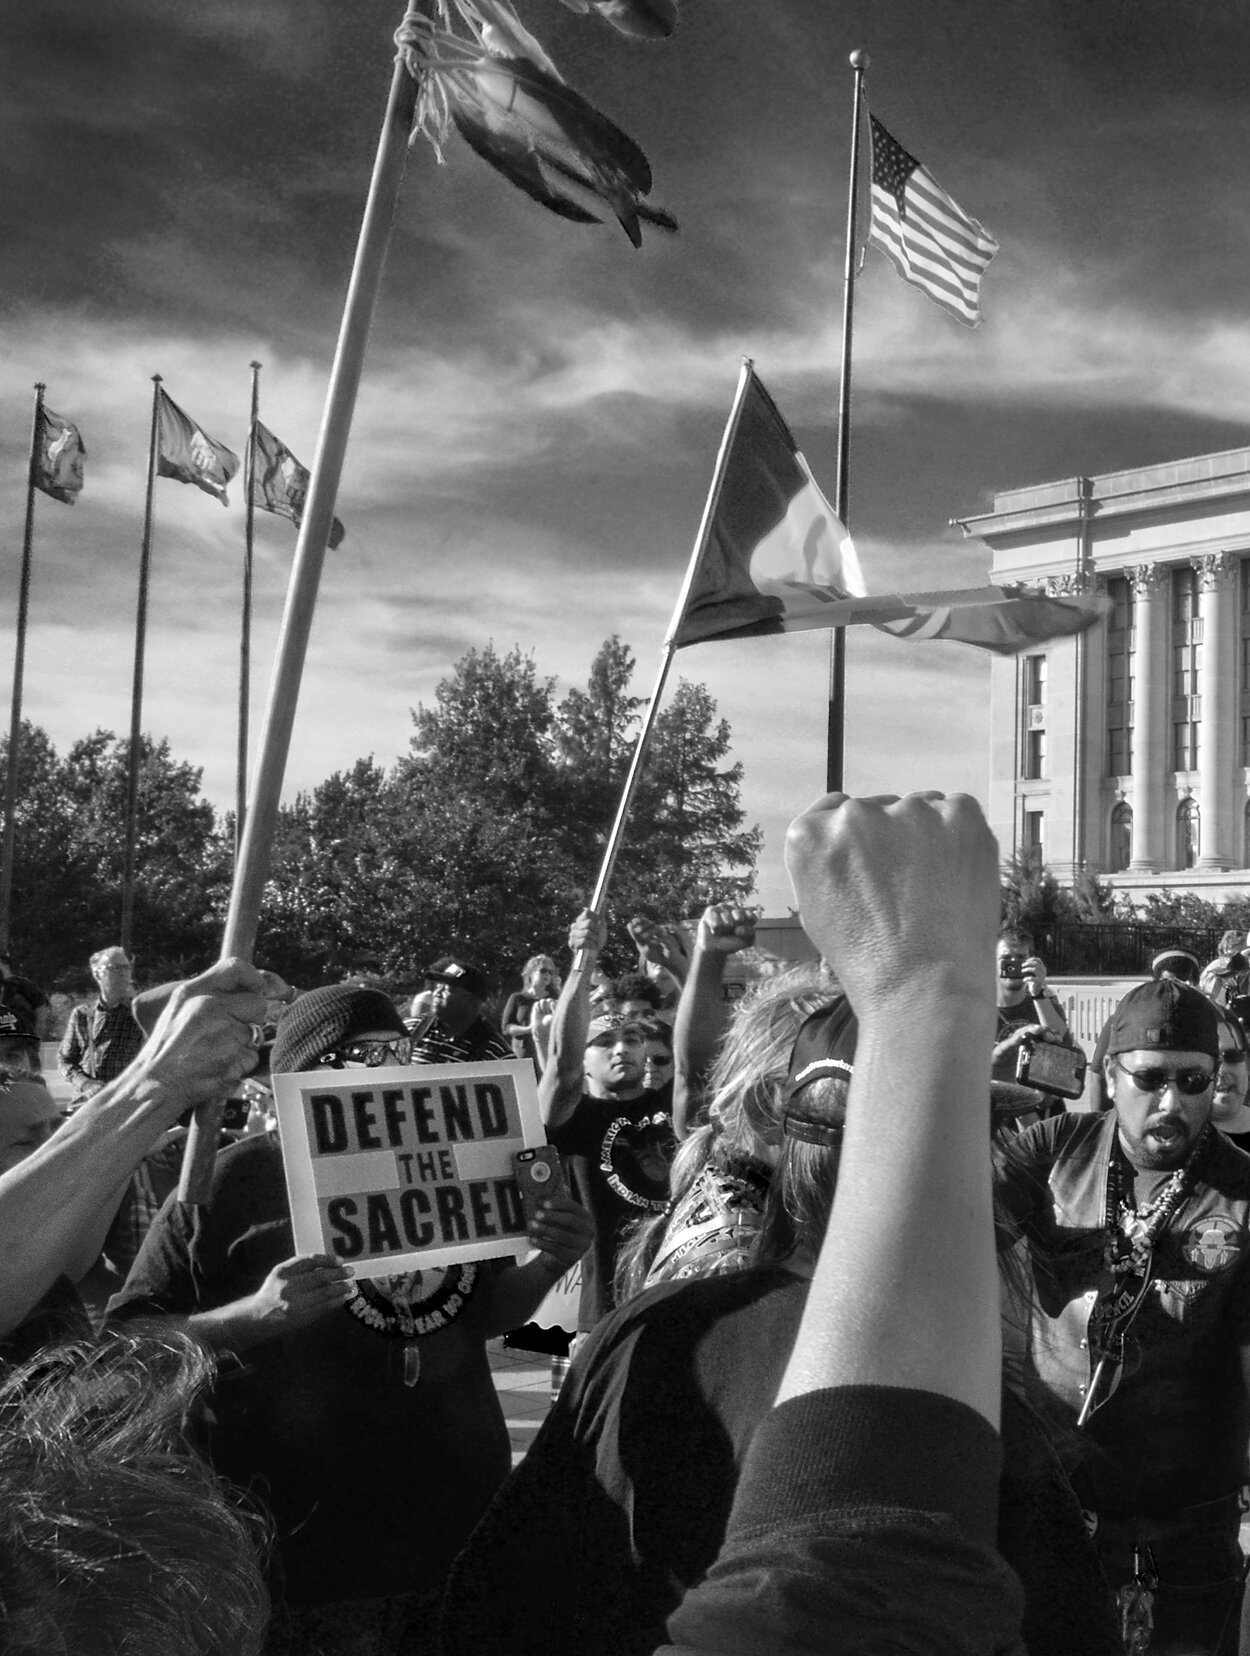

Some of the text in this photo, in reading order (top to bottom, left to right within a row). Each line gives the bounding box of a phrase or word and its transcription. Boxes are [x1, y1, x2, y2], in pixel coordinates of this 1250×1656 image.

[310, 1082, 509, 1154] DEFEND
[399, 1150, 454, 1184] THE
[607, 1173, 650, 1208] INDIAN
[327, 1179, 528, 1258] SACRED
